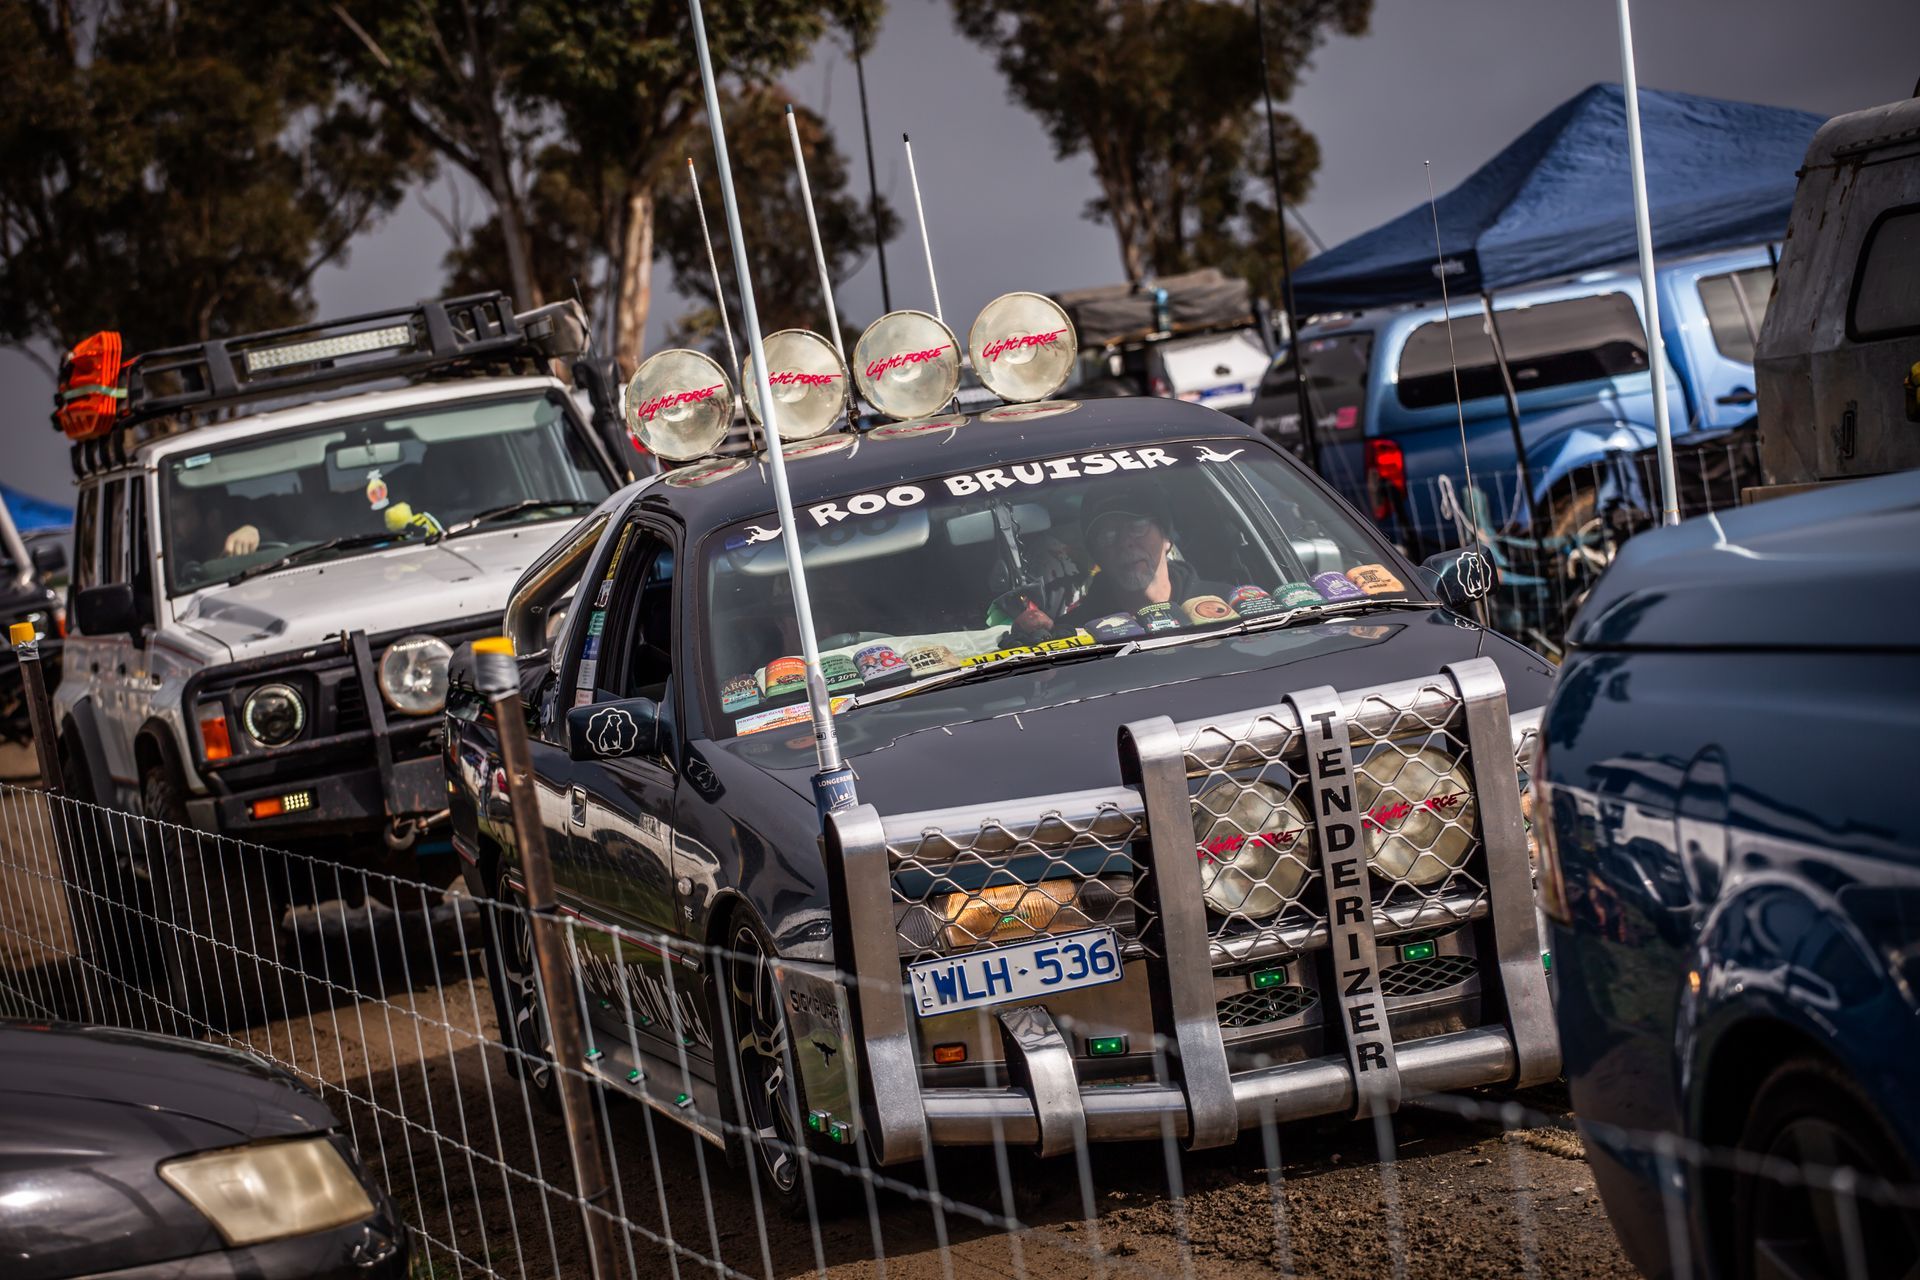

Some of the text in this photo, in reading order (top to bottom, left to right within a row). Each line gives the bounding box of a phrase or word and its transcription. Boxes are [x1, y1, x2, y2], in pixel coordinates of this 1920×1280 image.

[807, 447, 1179, 527] ROO BRUISER
[1311, 711, 1388, 1072] TENDERIZER
[916, 971, 934, 1008] VIC
